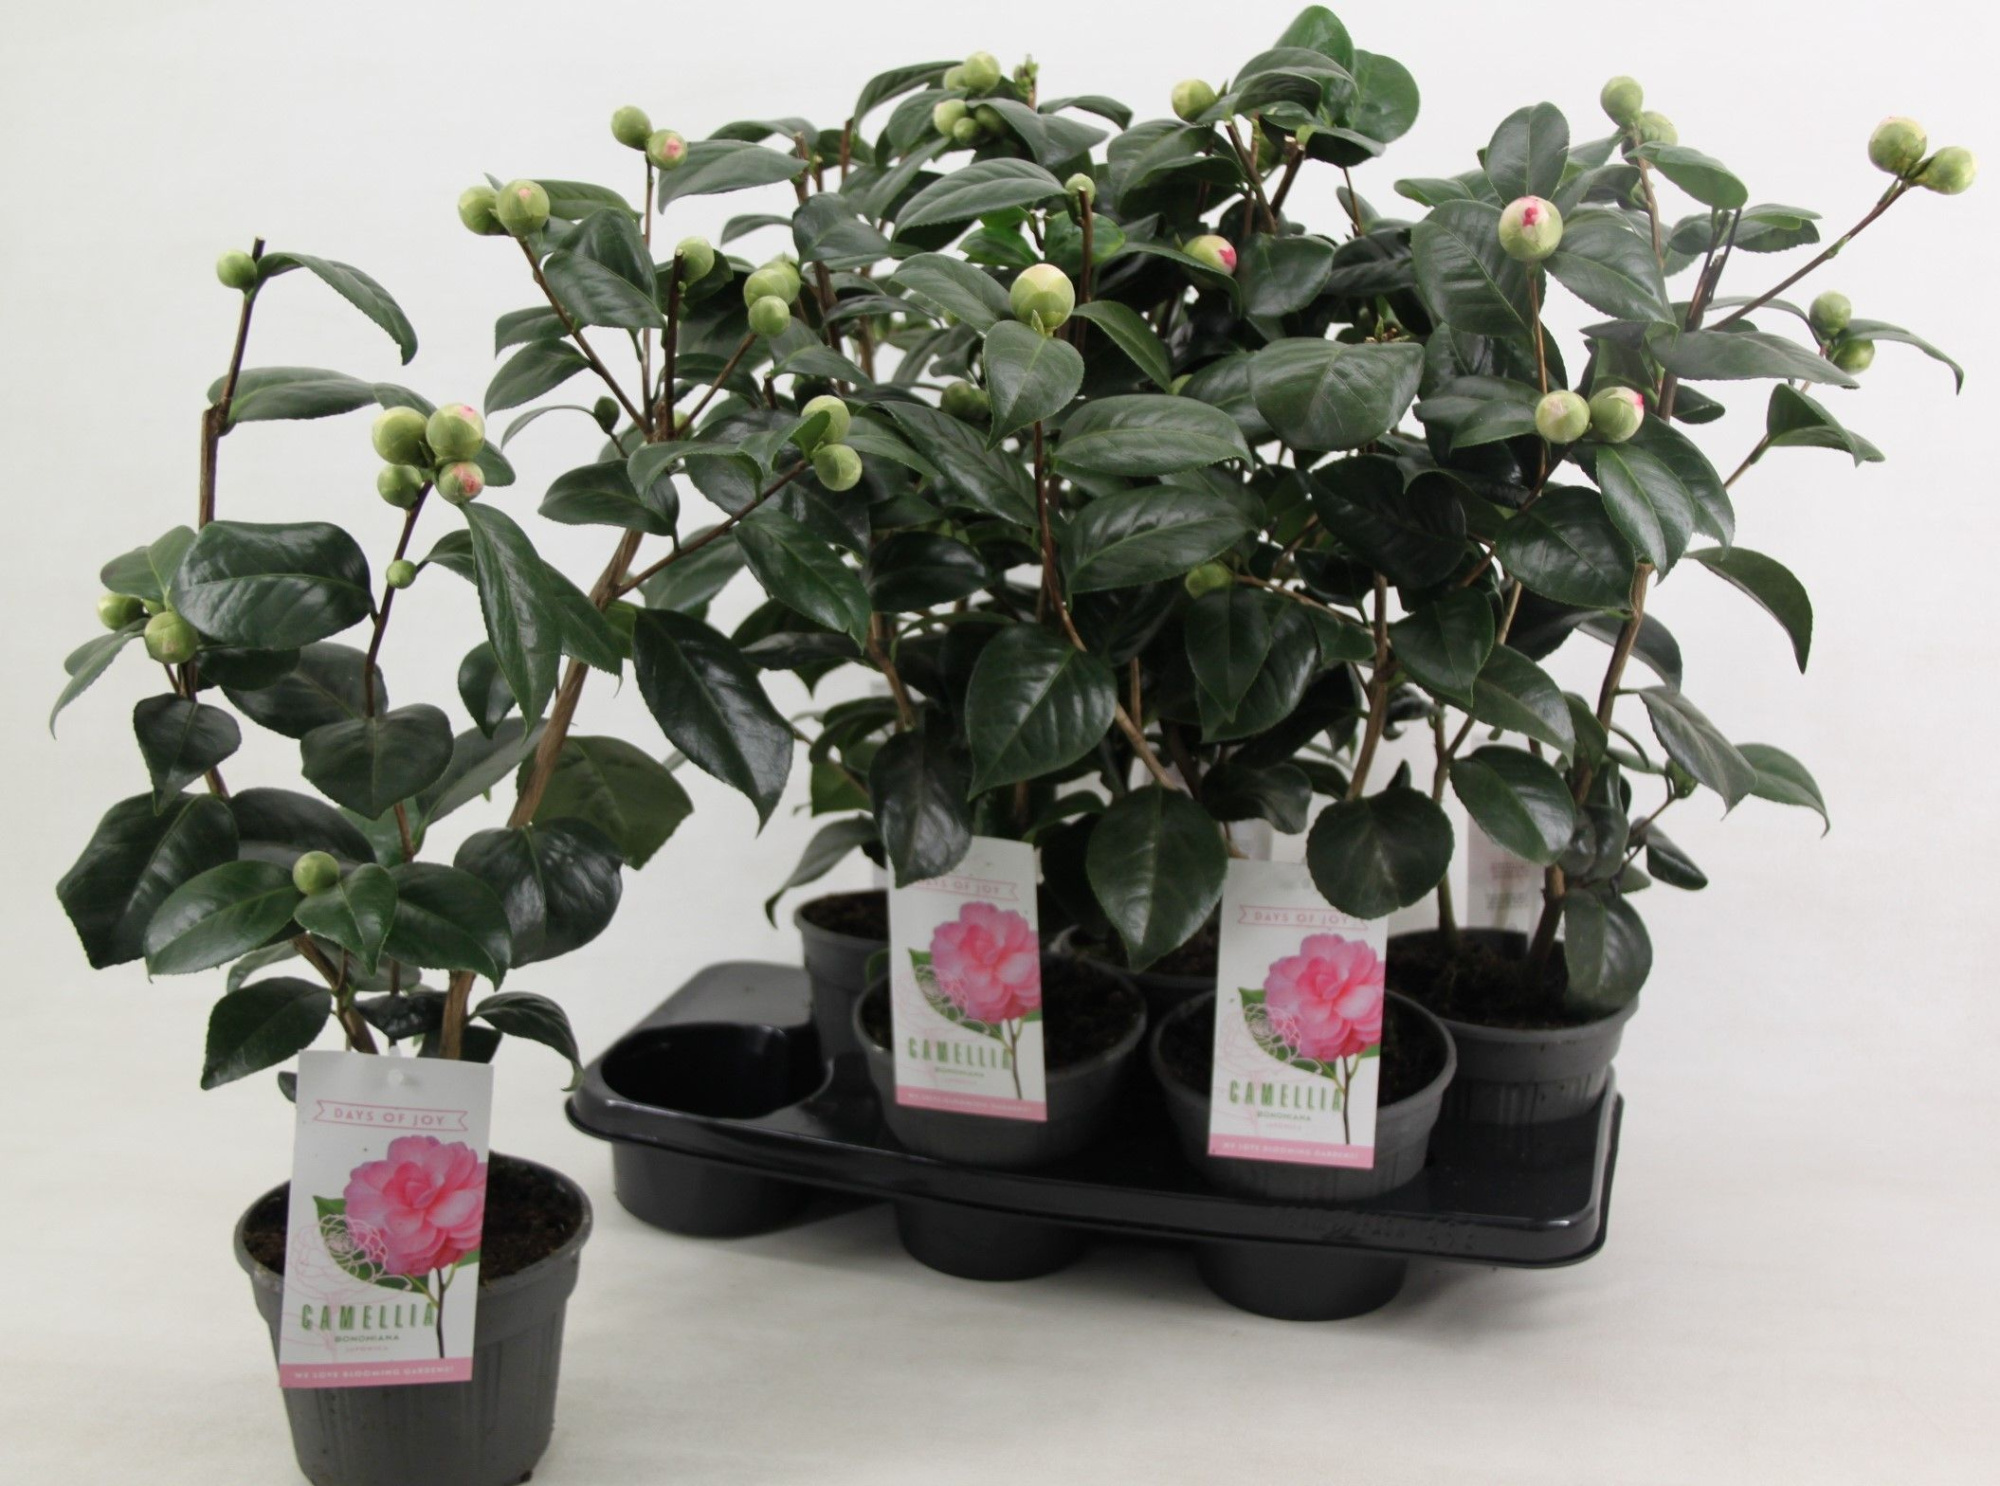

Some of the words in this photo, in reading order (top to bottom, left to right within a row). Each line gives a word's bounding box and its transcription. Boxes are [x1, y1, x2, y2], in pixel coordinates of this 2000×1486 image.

[1254, 911, 1289, 922] DAYS
[1296, 913, 1314, 923] OF
[1322, 914, 1348, 925] JOY
[909, 1036, 1011, 1070] CAMELLIA
[1229, 1079, 1341, 1112] CAMELLIA
[334, 1107, 374, 1121] DAYS
[383, 1112, 406, 1123] OF
[413, 1114, 445, 1127] JOY
[301, 1302, 435, 1331] CAMELLIA
